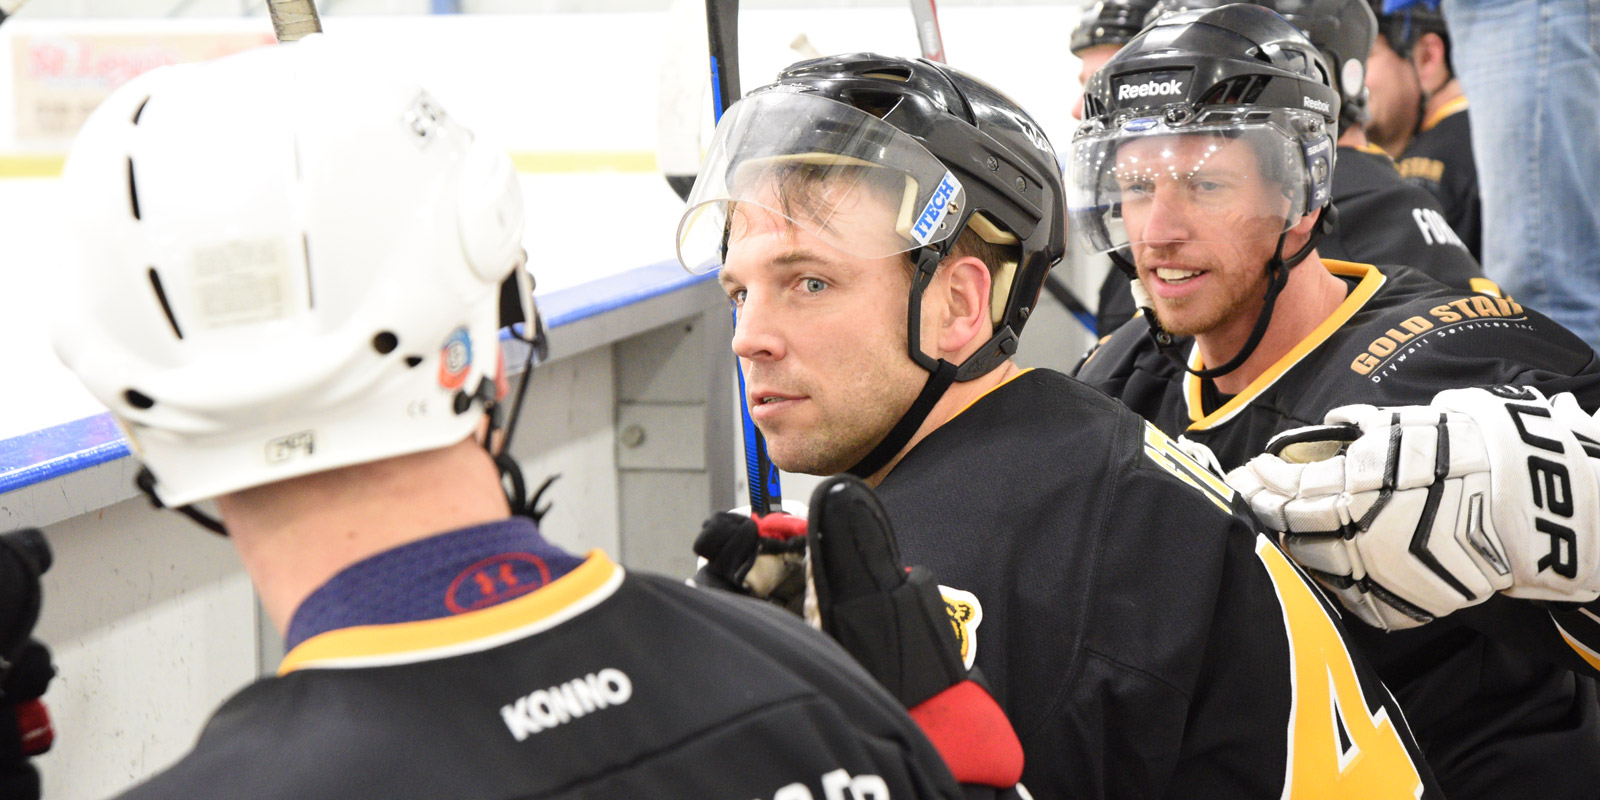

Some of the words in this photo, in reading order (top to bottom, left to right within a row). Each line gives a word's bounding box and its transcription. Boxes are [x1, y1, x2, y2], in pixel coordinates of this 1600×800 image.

[1118, 79, 1183, 100] Reebok
[1303, 96, 1330, 114] Reebok
[914, 179, 955, 239] ITECH
[1350, 316, 1434, 375] GOLD
[1371, 339, 1428, 384] Drywall
[1437, 322, 1510, 338] Services
[500, 668, 633, 742] KONNO
